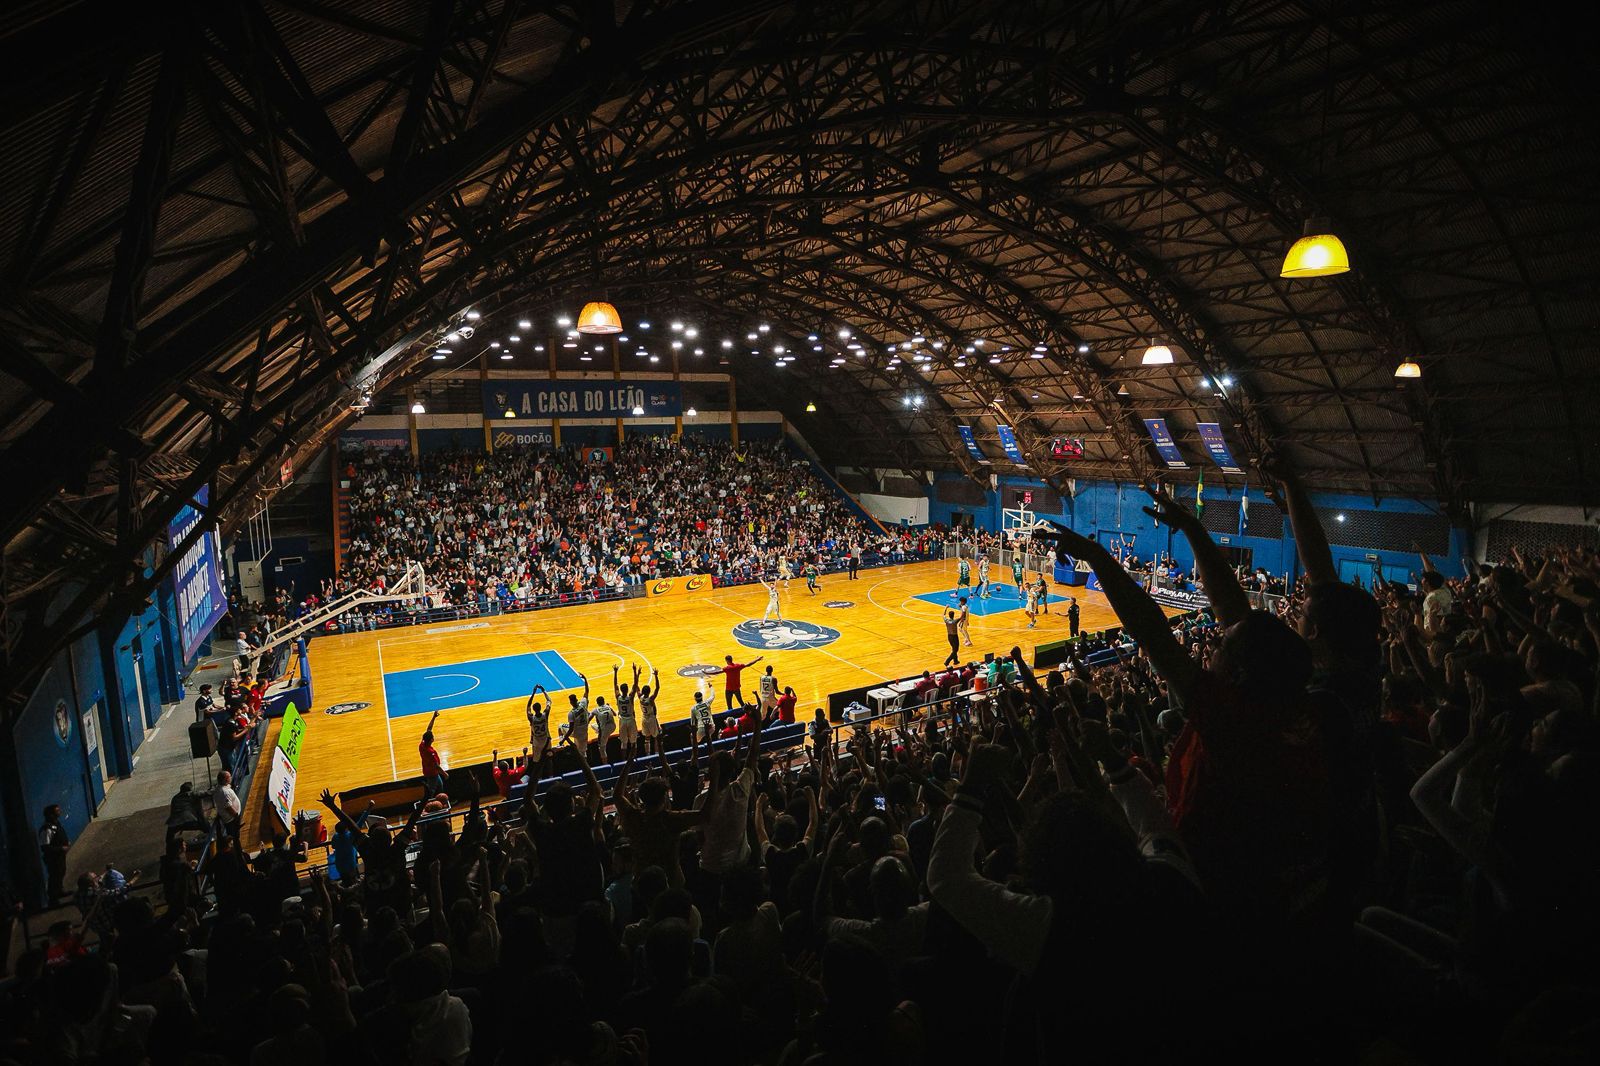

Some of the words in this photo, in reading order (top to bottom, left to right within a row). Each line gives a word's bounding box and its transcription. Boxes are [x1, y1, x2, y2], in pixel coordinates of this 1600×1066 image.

[522, 392, 531, 414] A
[538, 391, 578, 413] CASA
[584, 390, 603, 411] DO
[609, 385, 645, 410] LEÃO
[516, 432, 552, 444] BOCÃO
[699, 708, 709, 718] 15
